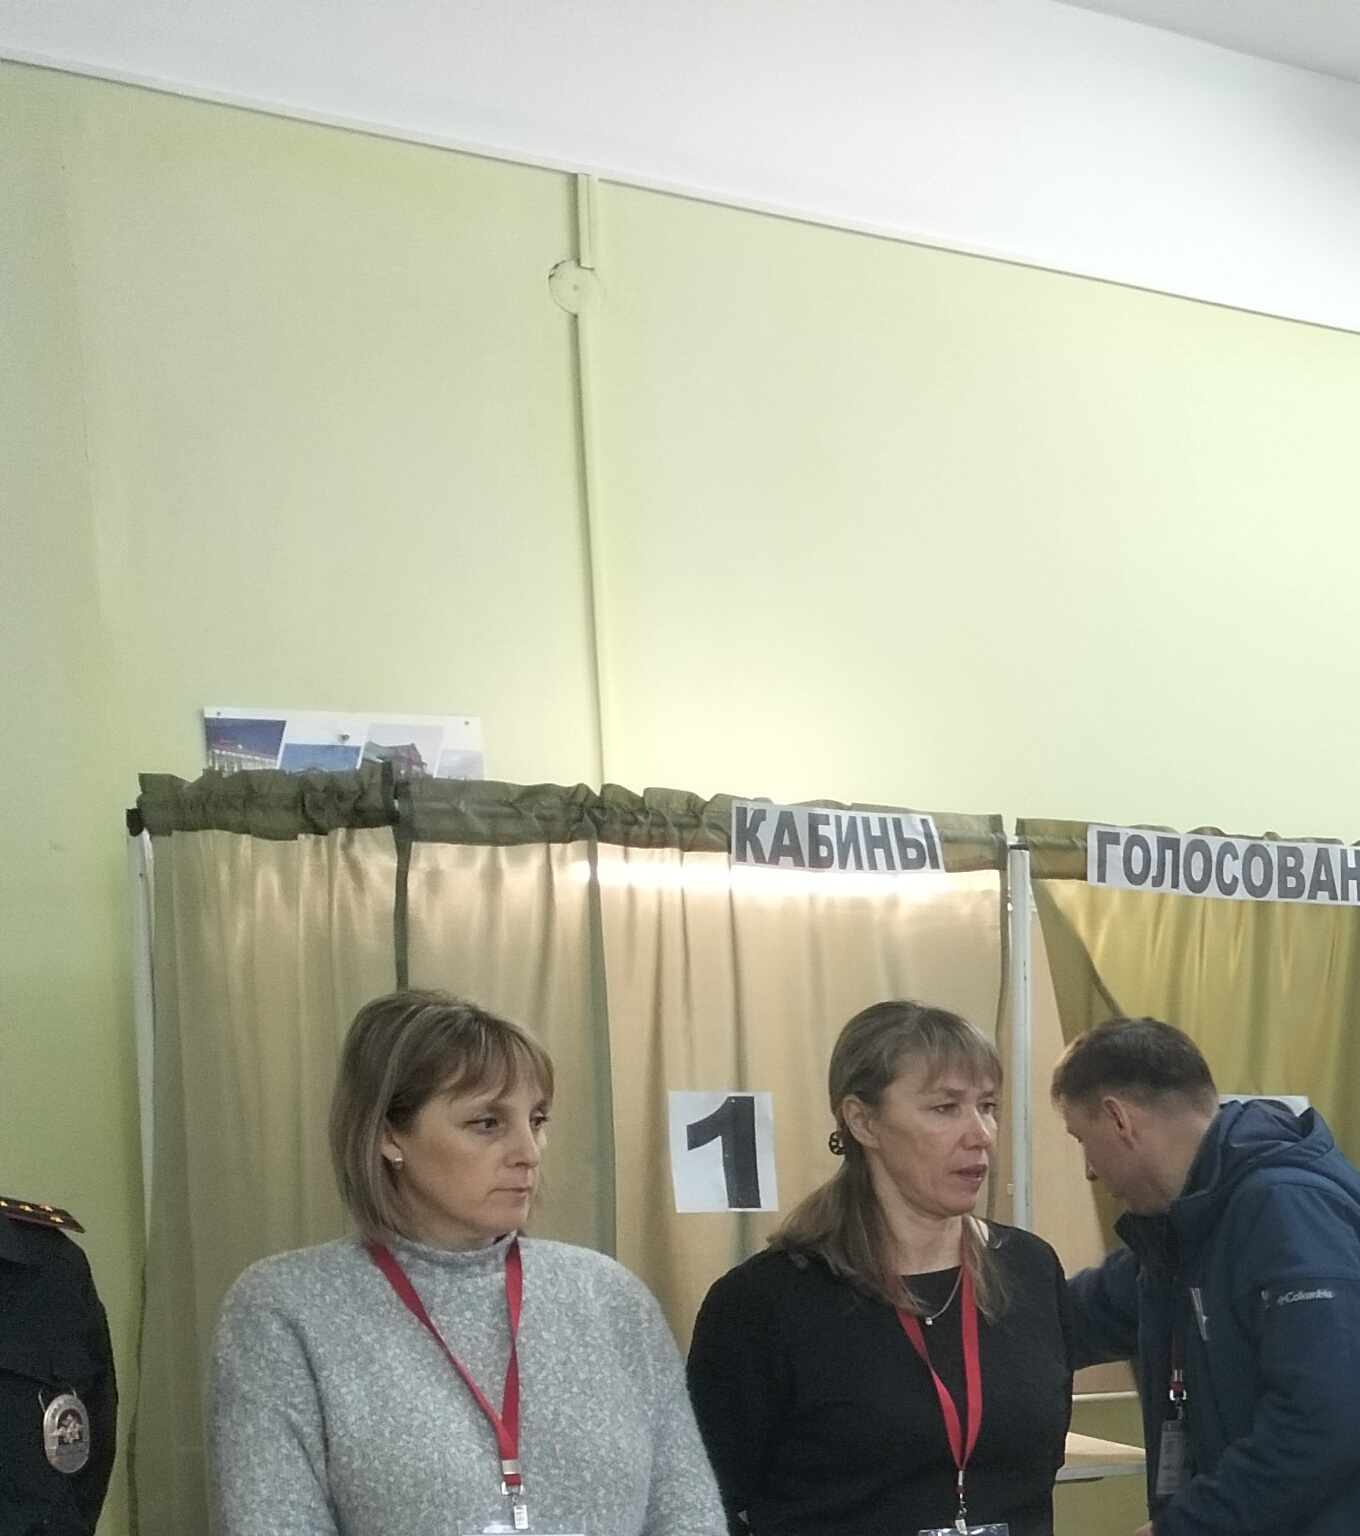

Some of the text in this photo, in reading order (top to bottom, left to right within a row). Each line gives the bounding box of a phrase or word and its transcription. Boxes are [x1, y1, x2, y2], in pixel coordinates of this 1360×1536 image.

[734, 806, 942, 872] КАБИНЫ
[686, 1096, 762, 1209] 1
[1285, 1289, 1334, 1303] Columbia
